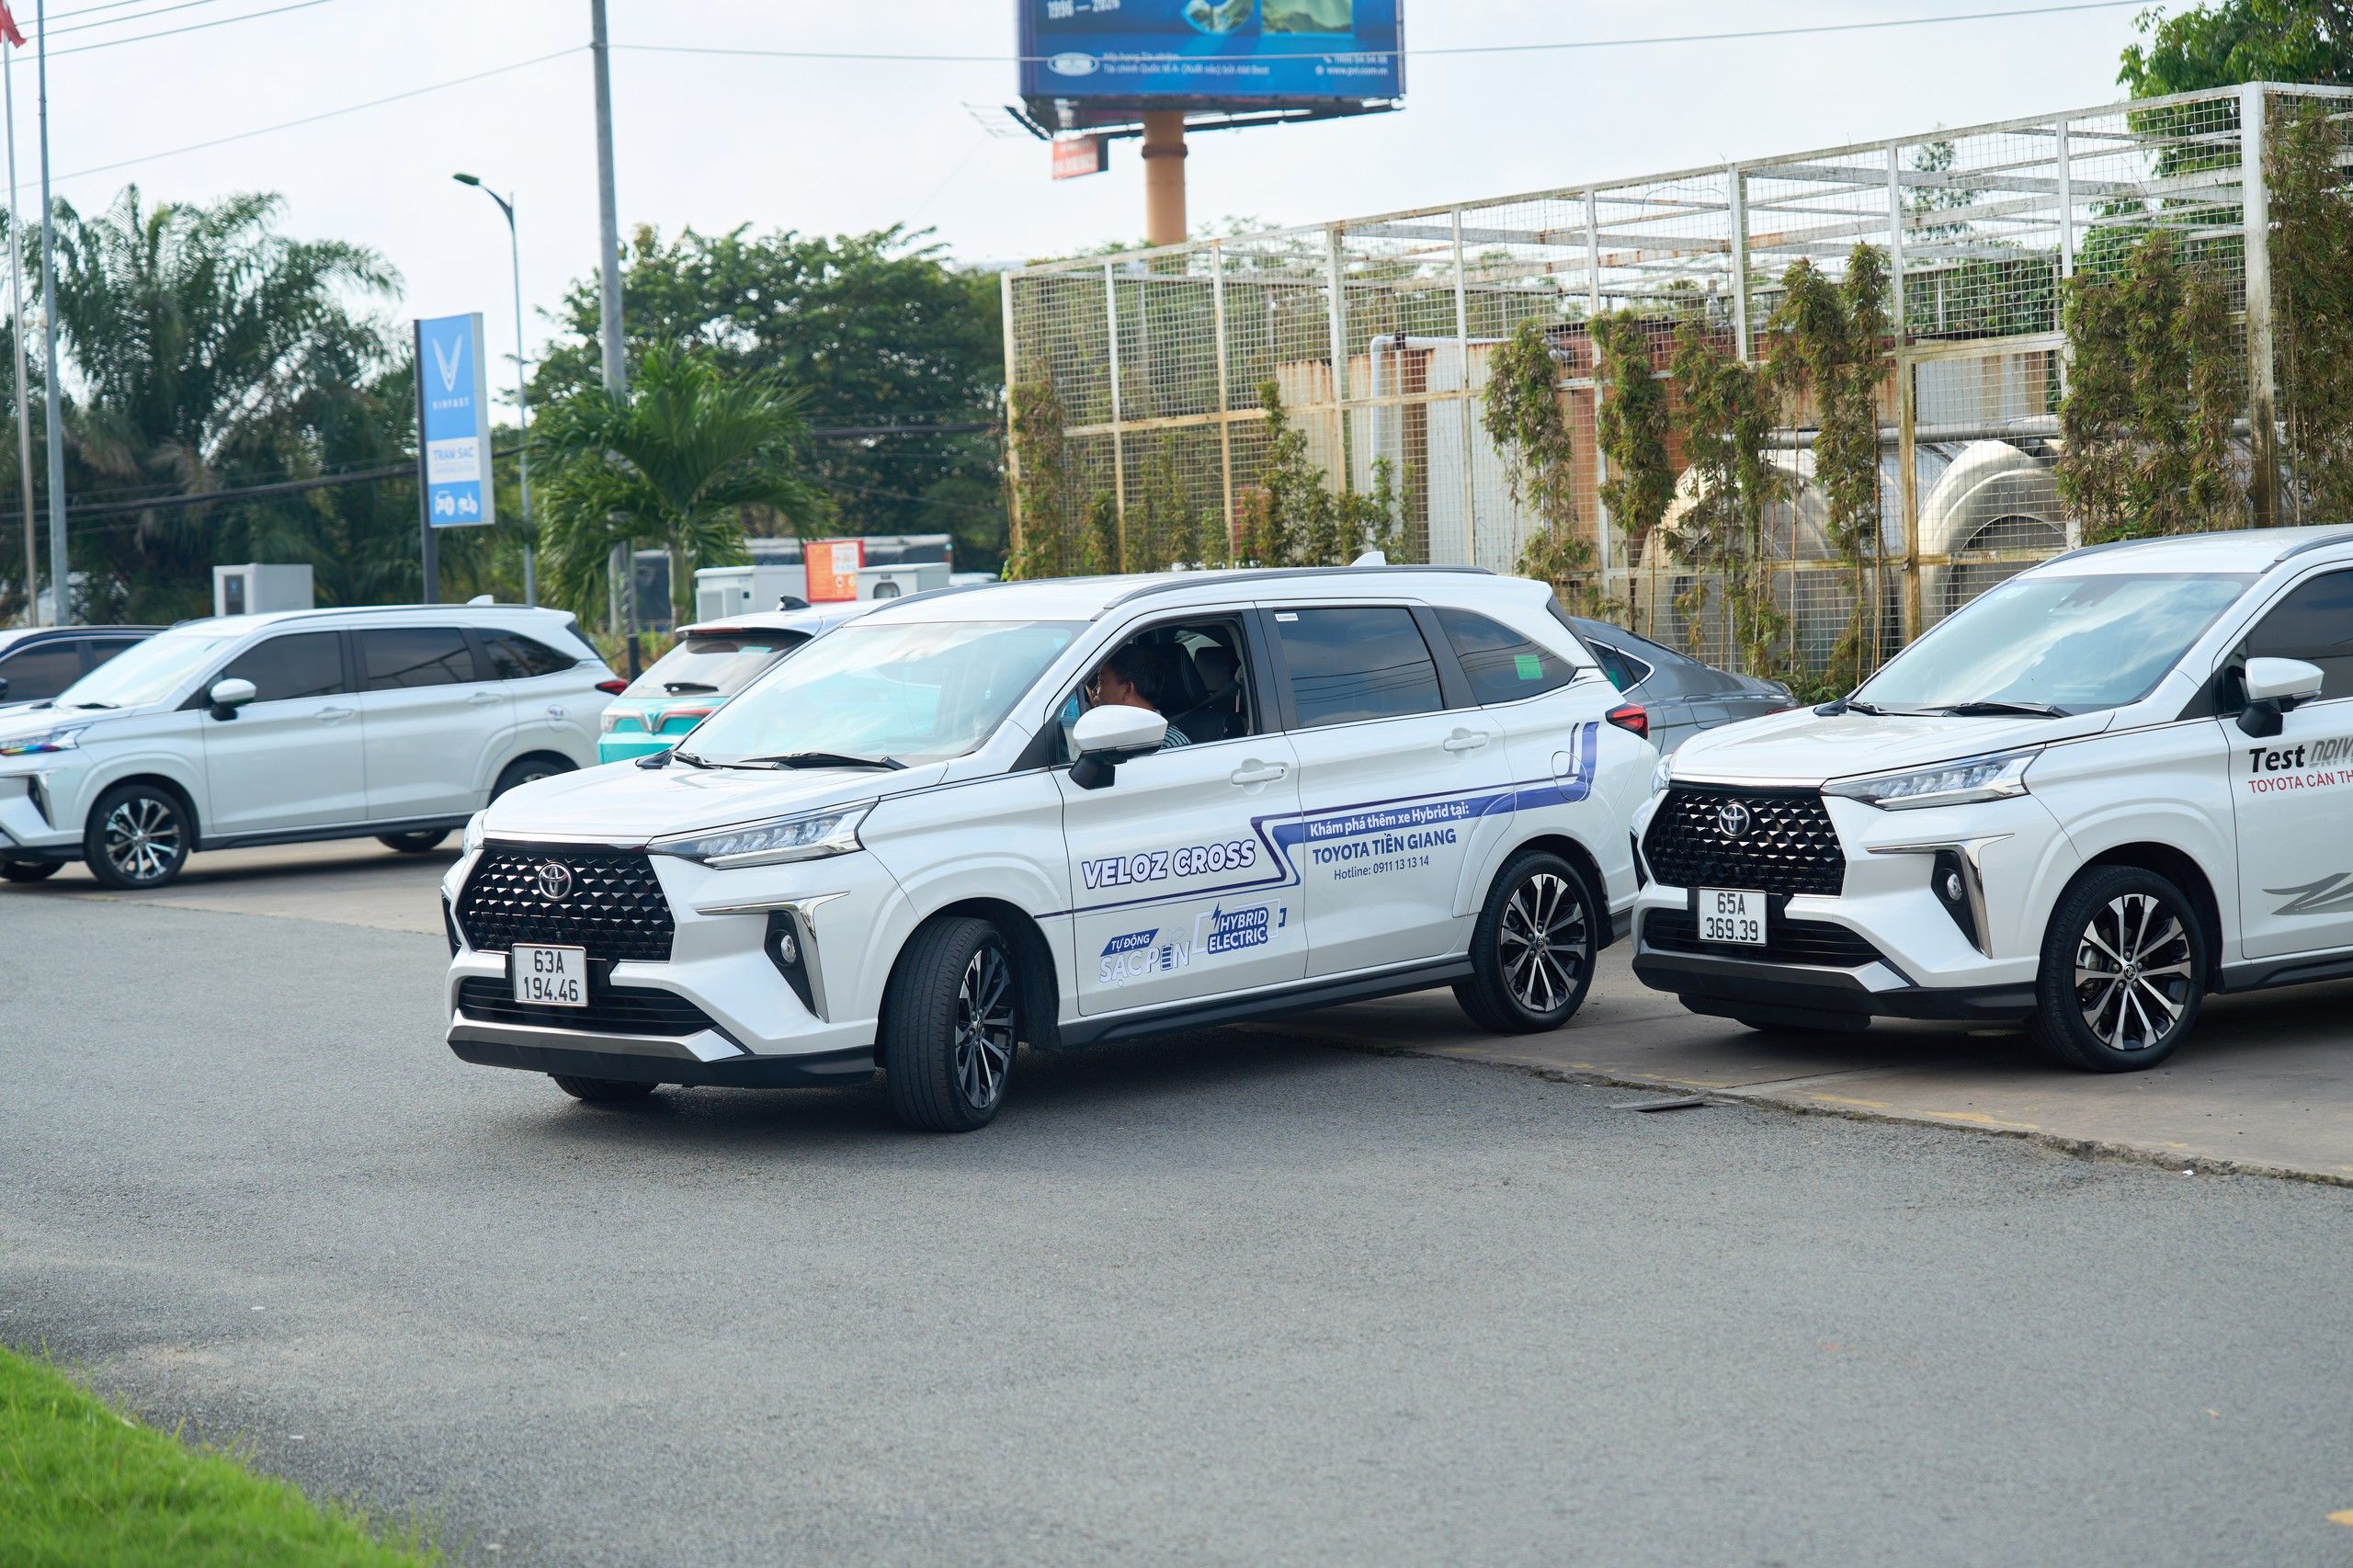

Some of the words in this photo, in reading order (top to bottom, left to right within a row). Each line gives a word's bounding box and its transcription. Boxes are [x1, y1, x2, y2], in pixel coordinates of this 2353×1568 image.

[2248, 744, 2305, 773] Test
[2308, 737, 2353, 768] DRIV
[2248, 776, 2304, 793] TOYOTA
[1310, 822, 1345, 837] Khám
[1345, 816, 1366, 835] phá
[1367, 812, 1396, 829] thêm
[1397, 813, 1411, 824] xe
[1412, 805, 1449, 824] Hybrid
[1449, 801, 1470, 820] tại:
[1313, 841, 1370, 865] TOYOTA
[1372, 833, 1404, 856] TIỀN
[1407, 828, 1457, 849] GIANG
[1082, 851, 1168, 890] VELOZ
[1173, 839, 1256, 877] CROSS
[1334, 865, 1371, 881] Hotline:
[1373, 861, 1392, 874] 0911
[1395, 859, 1405, 870] 13
[1407, 857, 1417, 869] 13
[1420, 856, 1429, 866] 14
[1717, 892, 1745, 915] 65A
[1220, 908, 1268, 932] HYBRID
[1706, 917, 1758, 941] 369.39
[1111, 937, 1124, 952] TỰ
[1123, 934, 1150, 949] ĐỘNG
[1209, 926, 1267, 952] ELECTRIC
[534, 949, 564, 974] 63A
[1099, 950, 1143, 987] SẠC
[1146, 941, 1191, 973] PIN
[524, 976, 579, 1002] 194.46
